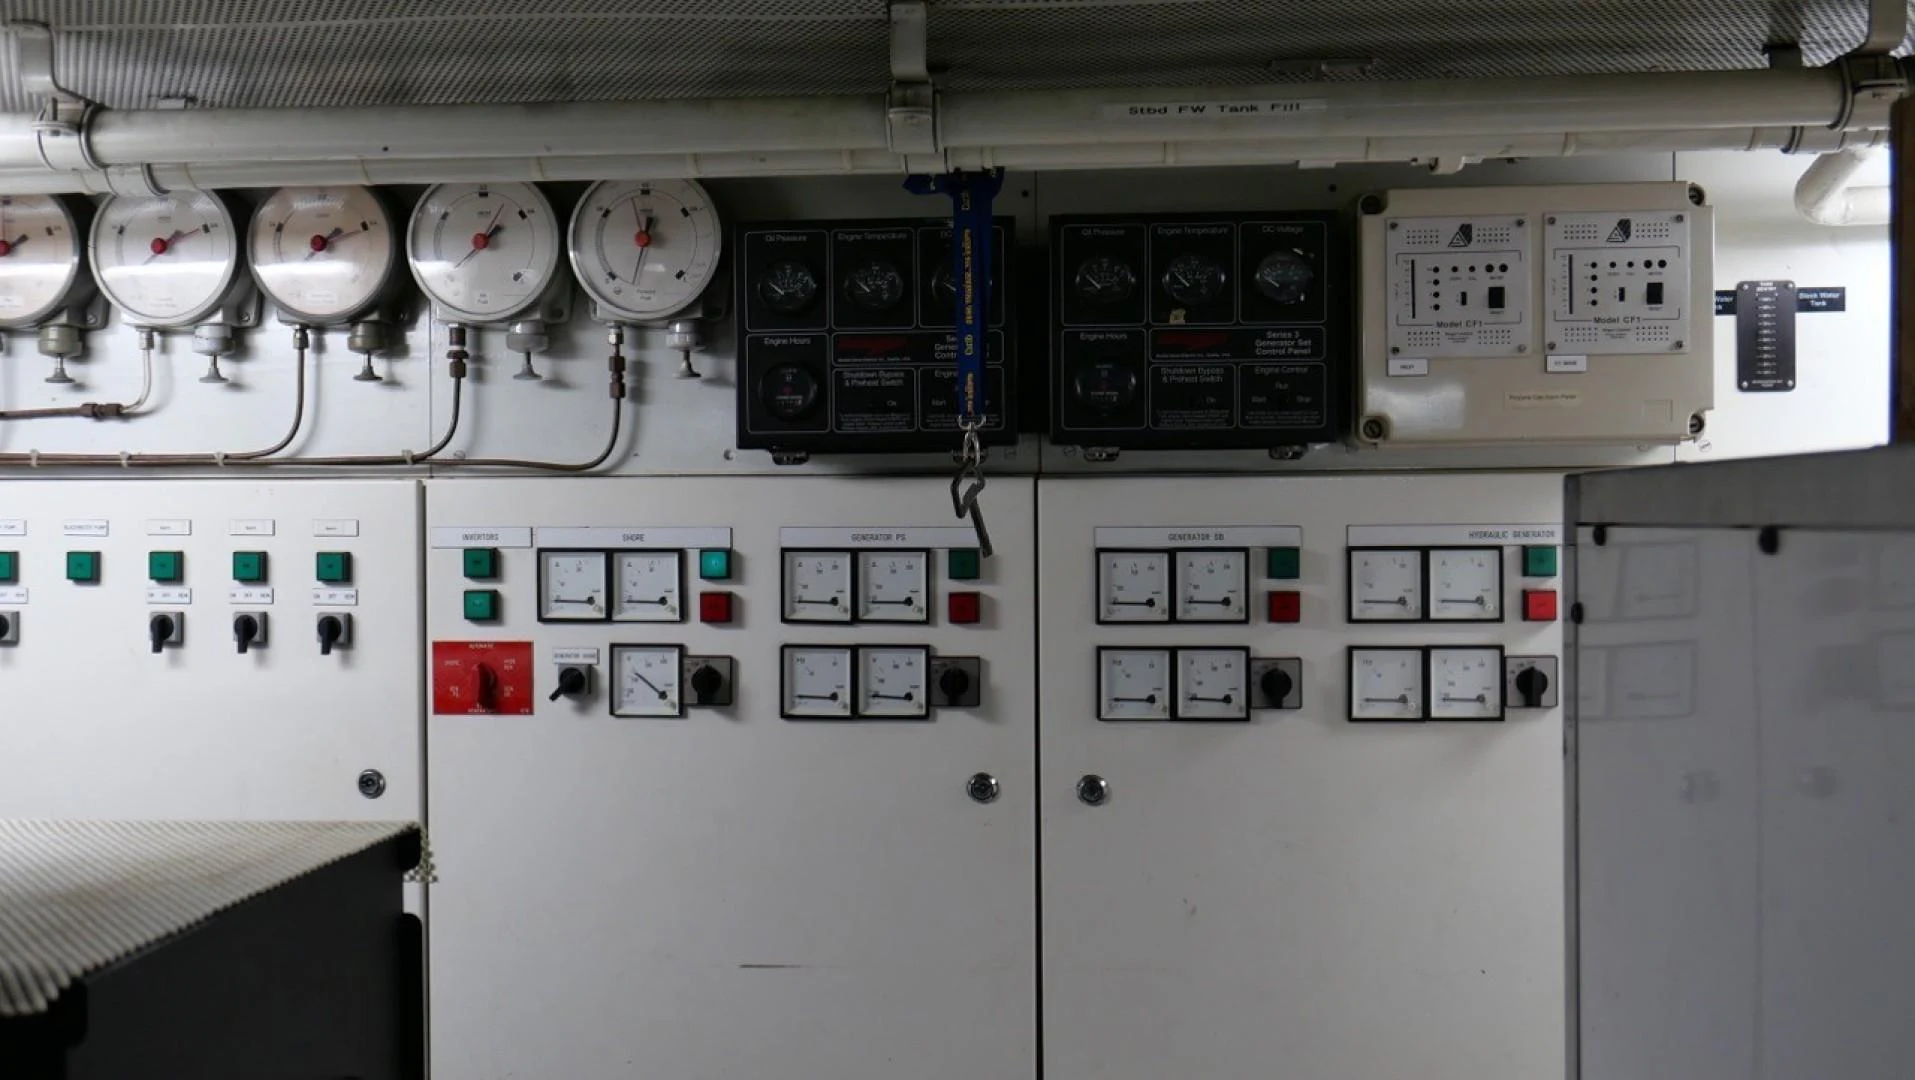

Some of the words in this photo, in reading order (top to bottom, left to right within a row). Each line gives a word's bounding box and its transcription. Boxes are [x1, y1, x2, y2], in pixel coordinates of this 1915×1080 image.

[1129, 105, 1168, 115] Stbd
[1178, 105, 1206, 114] FW
[1217, 104, 1259, 113] Tank
[1271, 102, 1300, 111] Fill
[1093, 228, 1125, 236] Pressure
[1183, 226, 1229, 236] Temperature
[1276, 225, 1304, 234] Voltage
[776, 234, 808, 242] Pressure
[864, 232, 908, 241] Temperature
[1436, 320, 1462, 328] Model
[1465, 319, 1483, 328] CF1
[1593, 316, 1620, 324] Model
[1622, 316, 1641, 324] CF1
[1080, 332, 1104, 342] Engine
[1105, 332, 1128, 340] Hours
[1266, 331, 1294, 339] Series
[764, 337, 788, 346] Engine
[790, 336, 811, 345] Hours
[1255, 339, 1296, 348] Generator
[1298, 338, 1312, 346] Set
[1256, 348, 1286, 356] Control
[1288, 347, 1311, 355] Panel
[1160, 366, 1196, 375] Shutdown
[1198, 366, 1225, 376] Bypass
[1254, 366, 1279, 376] Engine
[1280, 366, 1308, 374] Control
[878, 372, 904, 380] Bypass
[1200, 375, 1223, 383] Switch
[622, 533, 644, 542] SHORE
[851, 533, 892, 542] GENERATOR
[1168, 533, 1210, 541] GENERATOR
[1468, 530, 1509, 538] HYDRAULIC
[1512, 530, 1555, 538] GENERATOR
